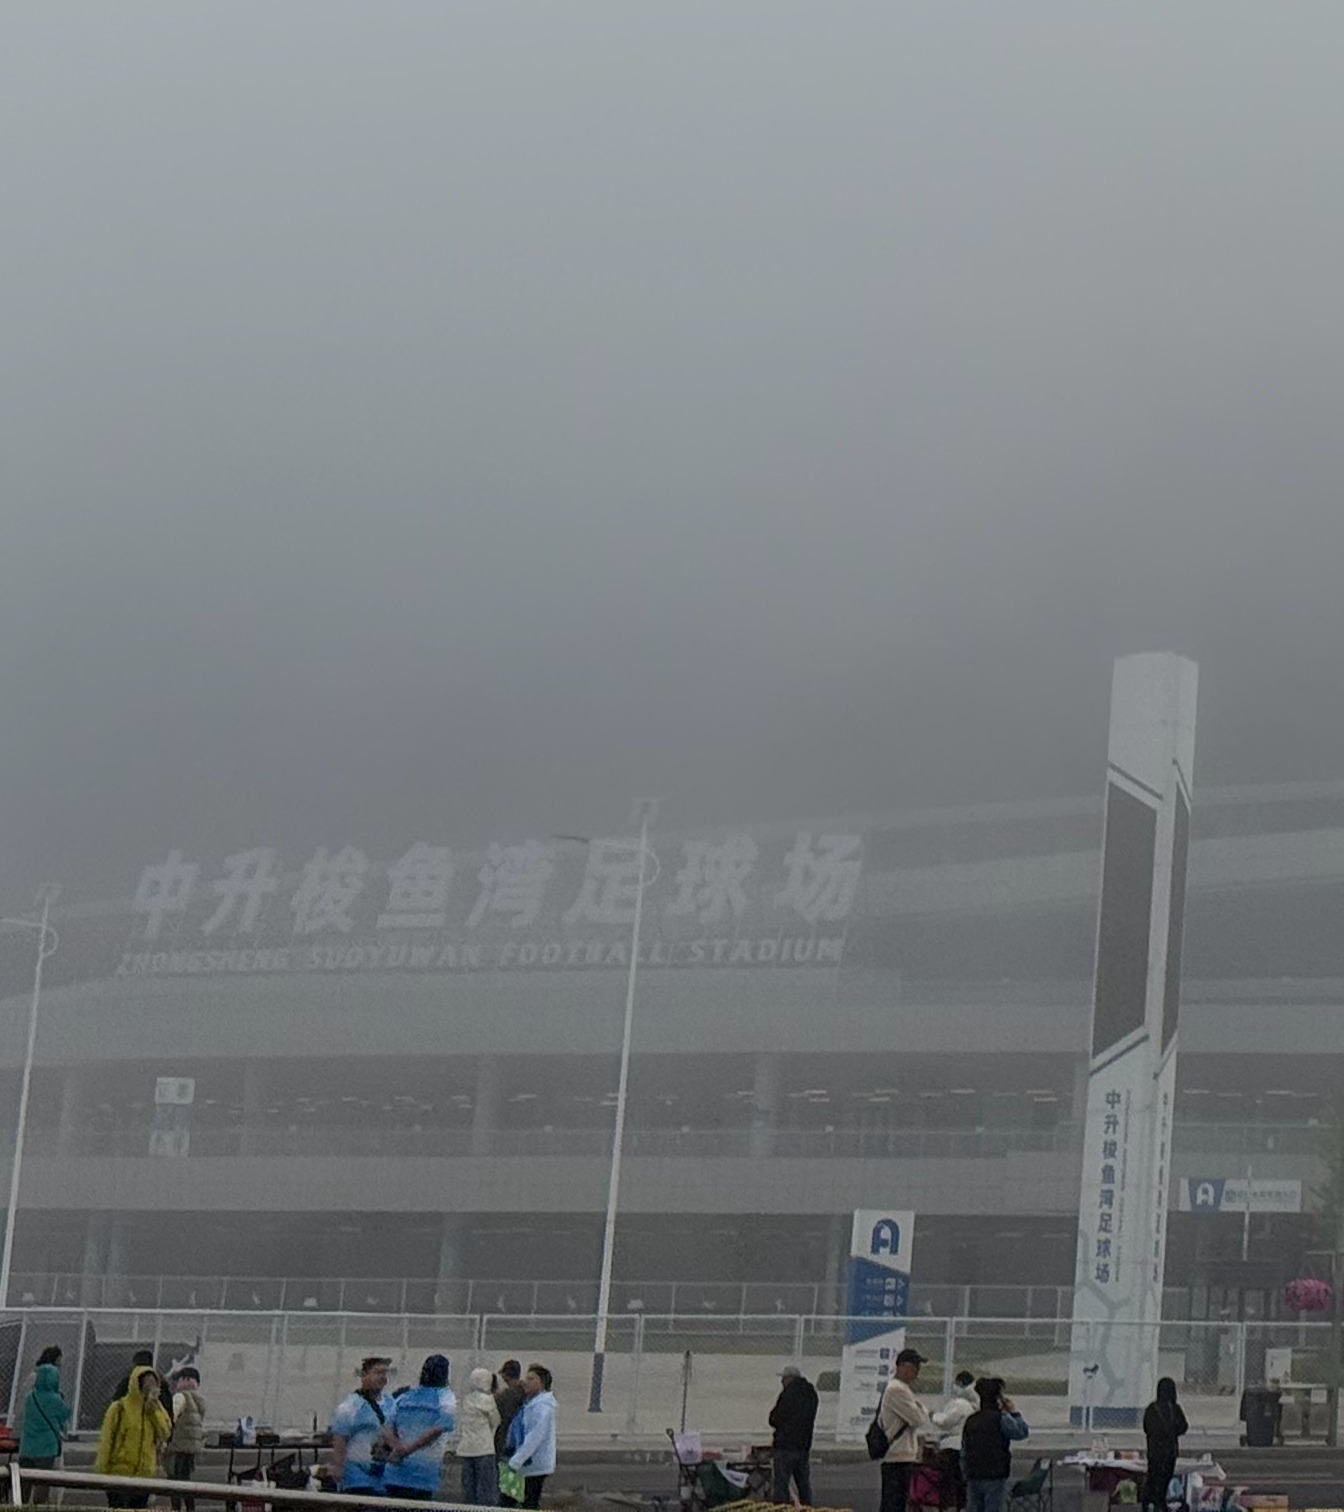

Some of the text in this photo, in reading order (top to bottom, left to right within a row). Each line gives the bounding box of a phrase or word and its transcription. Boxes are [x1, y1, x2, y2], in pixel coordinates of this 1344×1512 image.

[131, 831, 863, 939] 中升梭鱼湾足球场
[308, 944, 482, 969] SUOYUWAN
[500, 942, 662, 967] FOOTBALL
[690, 939, 845, 963] STADIUM
[1095, 1089, 1121, 1284] 中升梭鱼湾足球场
[871, 1218, 900, 1255] A
